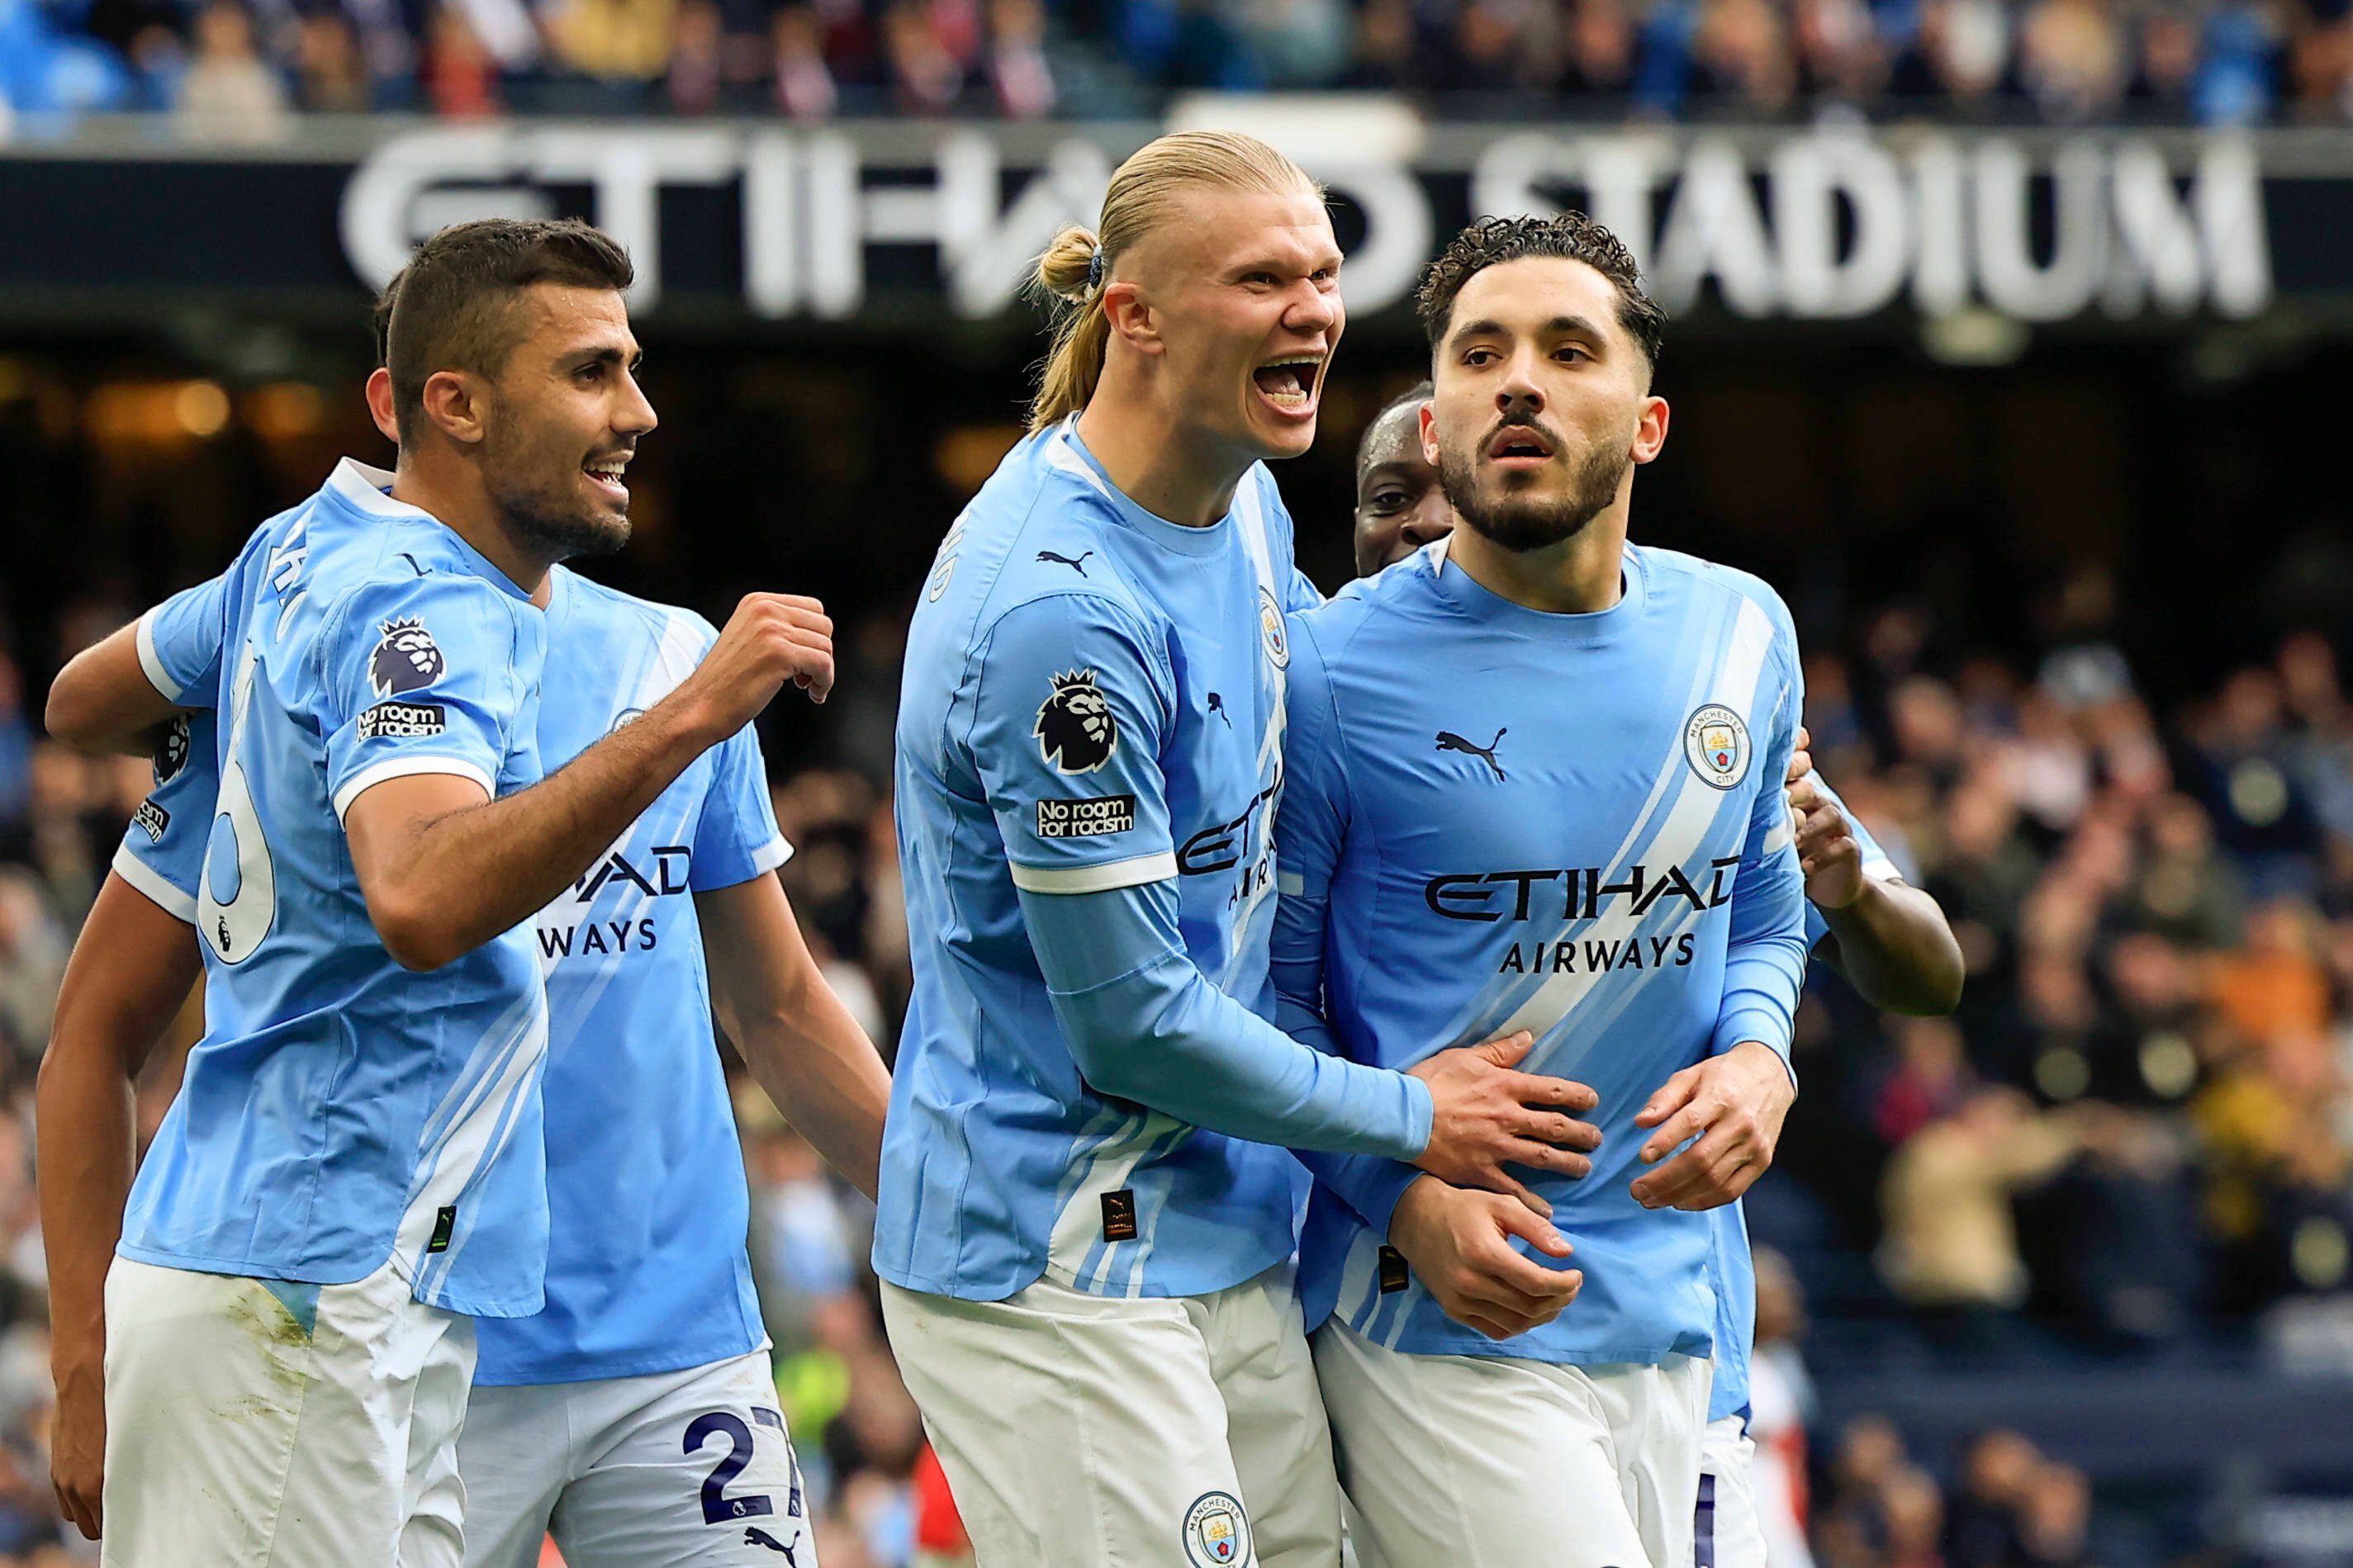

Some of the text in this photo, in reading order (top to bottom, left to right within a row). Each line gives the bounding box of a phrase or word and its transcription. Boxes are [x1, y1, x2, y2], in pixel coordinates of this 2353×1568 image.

[357, 705, 435, 727] No room
[378, 721, 444, 737] racism
[1690, 710, 1743, 738] MANCHESTER
[1716, 775, 1735, 784] CITY
[1037, 799, 1125, 820] No room
[1037, 814, 1133, 836] for racism
[1425, 855, 1742, 922] ETIHAD
[537, 918, 657, 959] WAYS
[1498, 932, 1696, 974] AIRWAYS
[682, 1406, 802, 1526] 27
[1189, 1498, 1241, 1532] MANCHESTER
